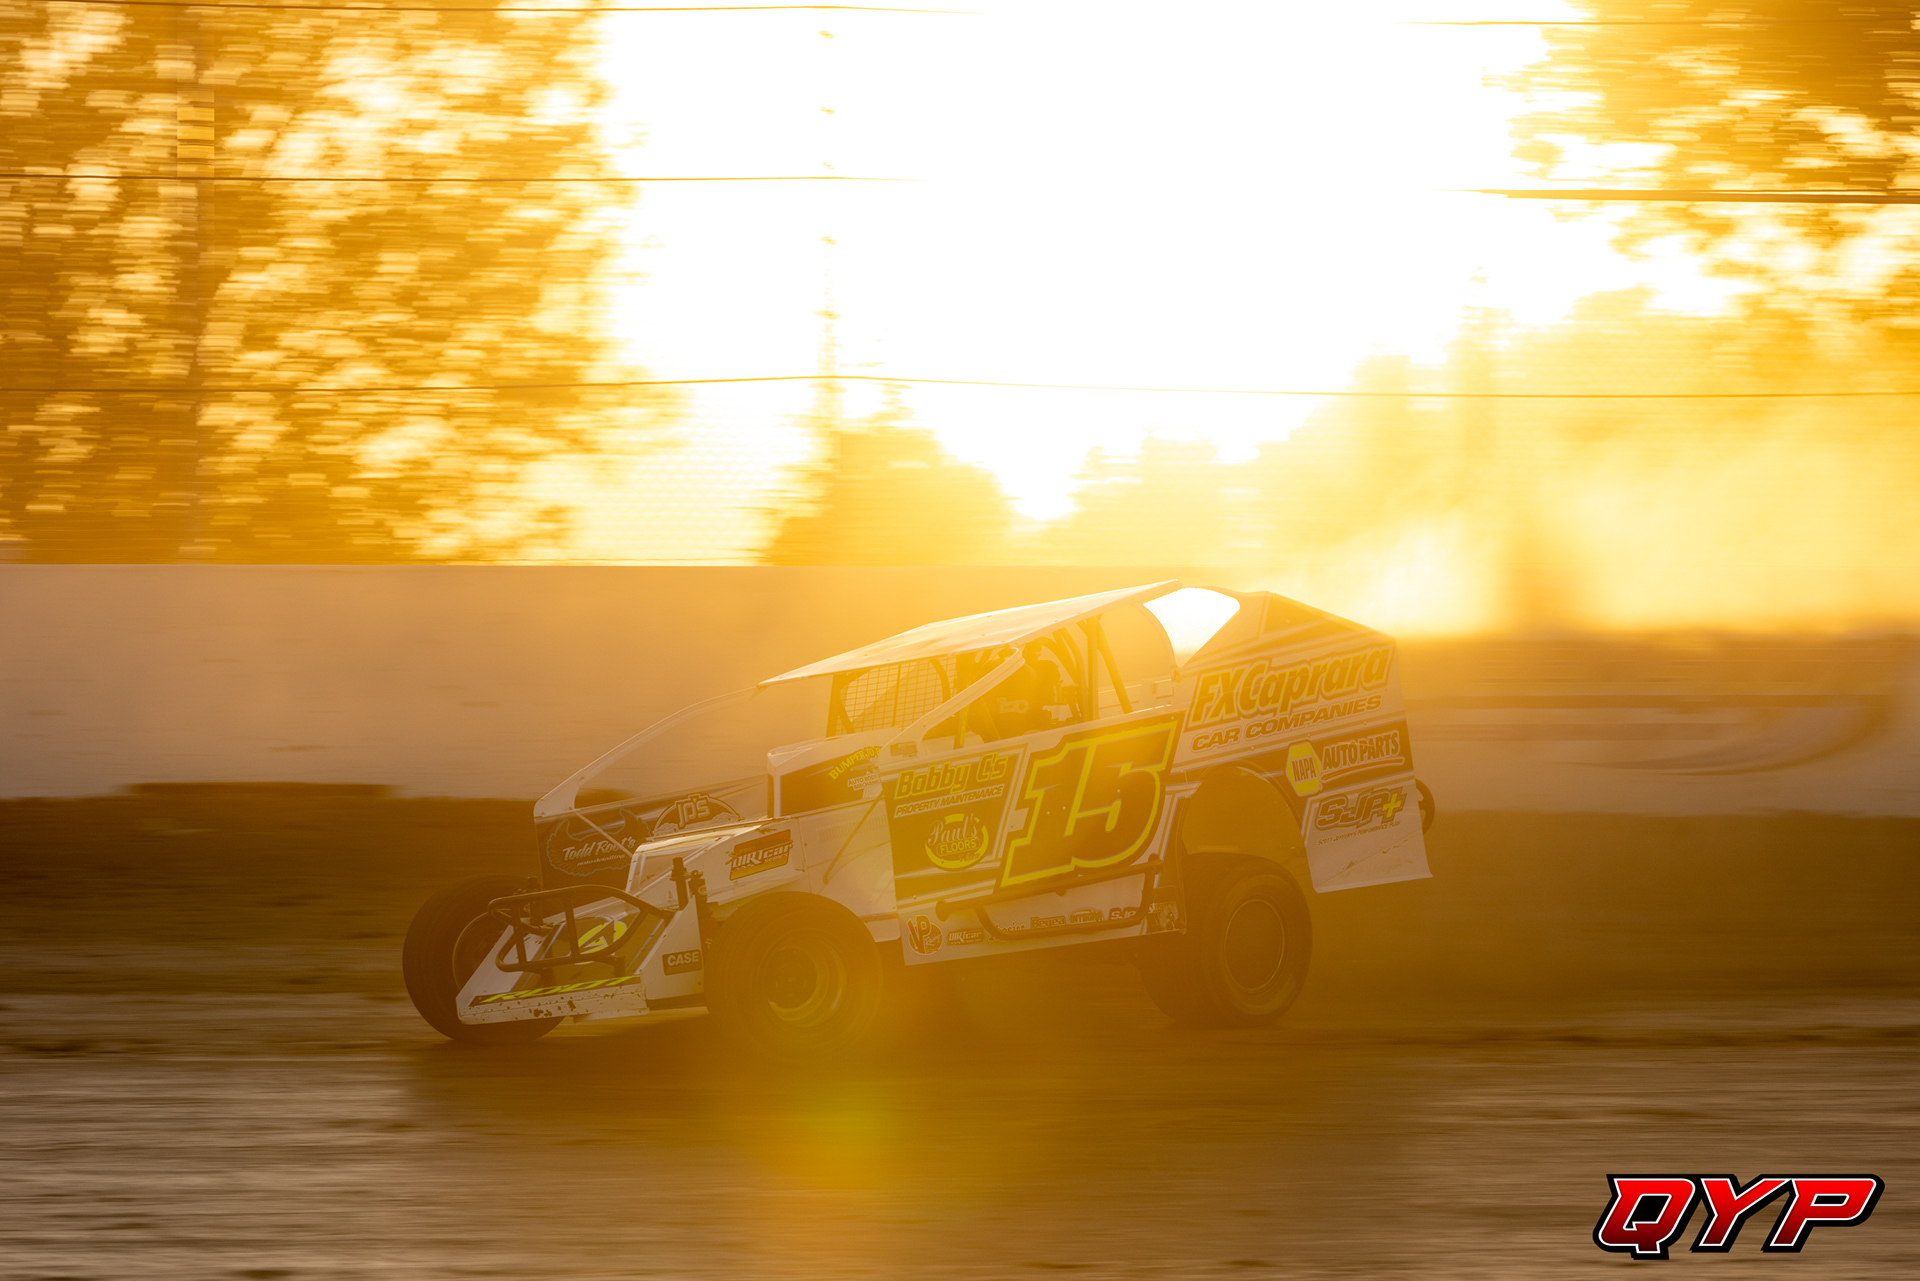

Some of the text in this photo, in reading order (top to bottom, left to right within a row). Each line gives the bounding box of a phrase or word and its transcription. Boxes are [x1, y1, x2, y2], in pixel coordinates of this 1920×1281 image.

[1192, 694, 1382, 753] CAR COMPANIES
[828, 750, 866, 779] BUMPER
[1322, 731, 1399, 772] AUTO PARTS
[894, 762, 972, 800] Bobby
[1291, 756, 1318, 783] NAPA
[894, 784, 1005, 818] PROPERTY MAINTENANCE
[1000, 720, 1178, 888] 15
[928, 813, 978, 846] Paul's
[940, 838, 977, 854] FLOORS
[562, 842, 596, 862] Todd
[667, 952, 699, 966] CASE
